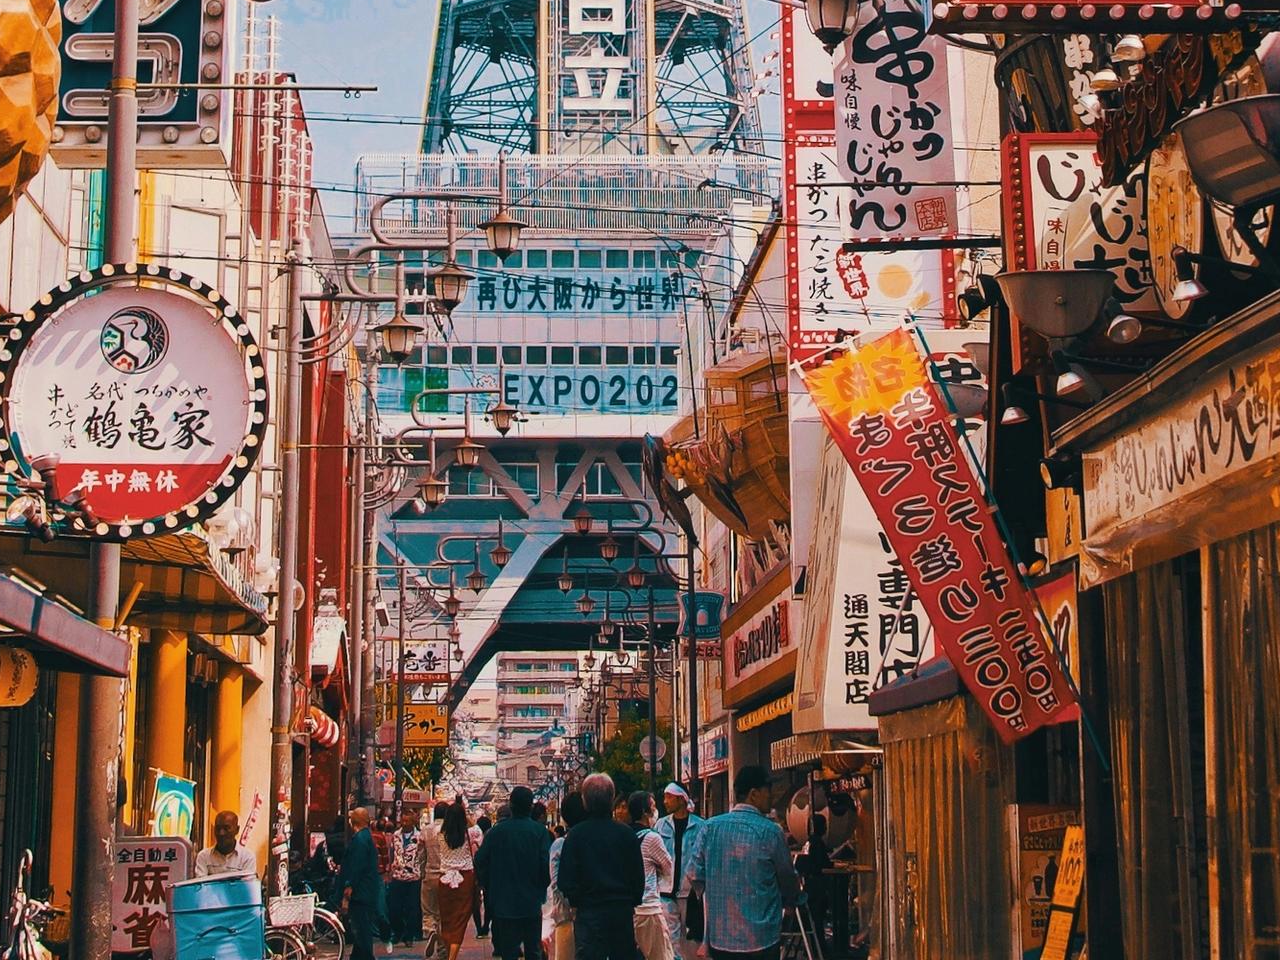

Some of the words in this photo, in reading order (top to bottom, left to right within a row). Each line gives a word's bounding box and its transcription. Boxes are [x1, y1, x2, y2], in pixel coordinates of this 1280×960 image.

[841, 69, 862, 132] 味自慢
[851, 11, 944, 162] 串かつ
[870, 102, 913, 196] じゃん
[807, 161, 830, 224] 串かつ
[846, 139, 908, 232] じゃん
[808, 234, 835, 323] たこ焼き
[837, 251, 869, 299] 新世界
[47, 382, 67, 431] 串かつ
[84, 381, 128, 401] 名代
[83, 399, 215, 451] 鶴亀家
[76, 468, 180, 493] 年中無休
[843, 593, 871, 707] 通天閣店
[116, 847, 178, 864] 全自動卓
